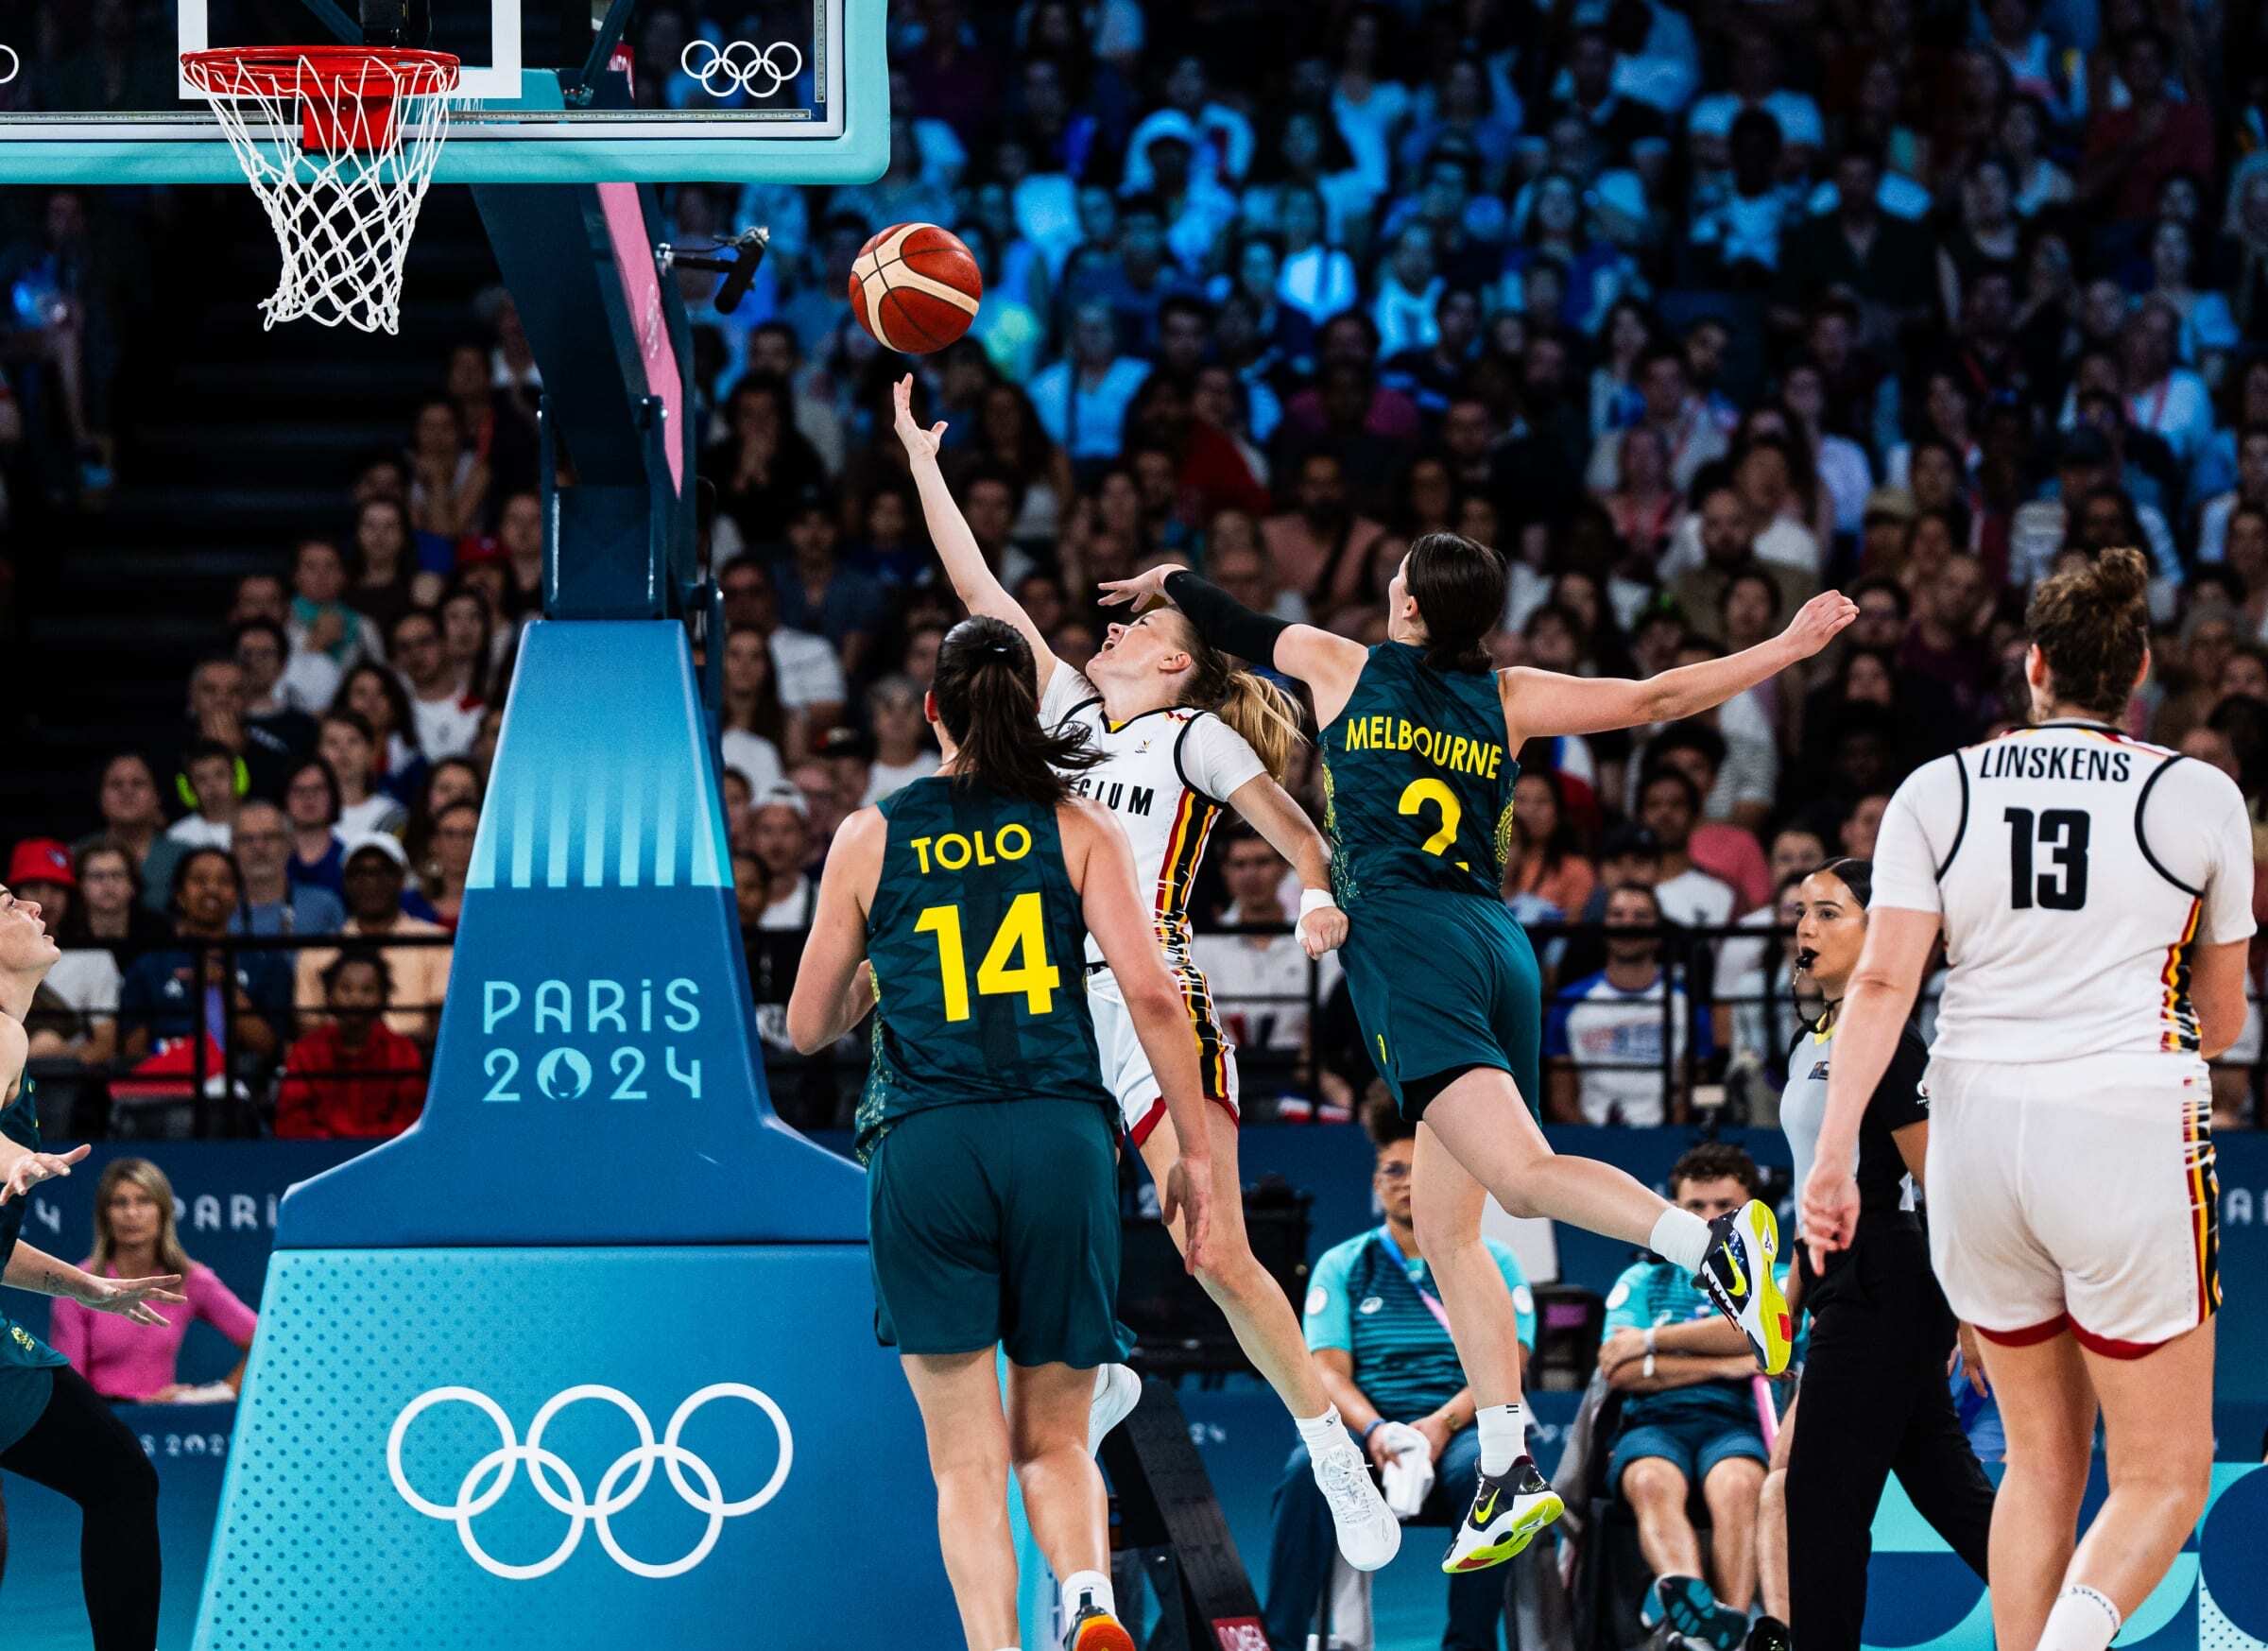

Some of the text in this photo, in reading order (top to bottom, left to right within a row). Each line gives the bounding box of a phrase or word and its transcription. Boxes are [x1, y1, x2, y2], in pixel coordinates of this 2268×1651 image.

[1345, 715, 1503, 780] MELBOURNE
[1979, 745, 2131, 783] LINSKENS
[1078, 778, 1155, 817] GIUM
[1398, 778, 1469, 872] 2
[910, 823, 1032, 874] TOLO
[2002, 806, 2091, 911] 13
[914, 891, 1060, 1023] 14
[482, 1046, 701, 1102] 2024
[165, 1433, 226, 1457] 202
